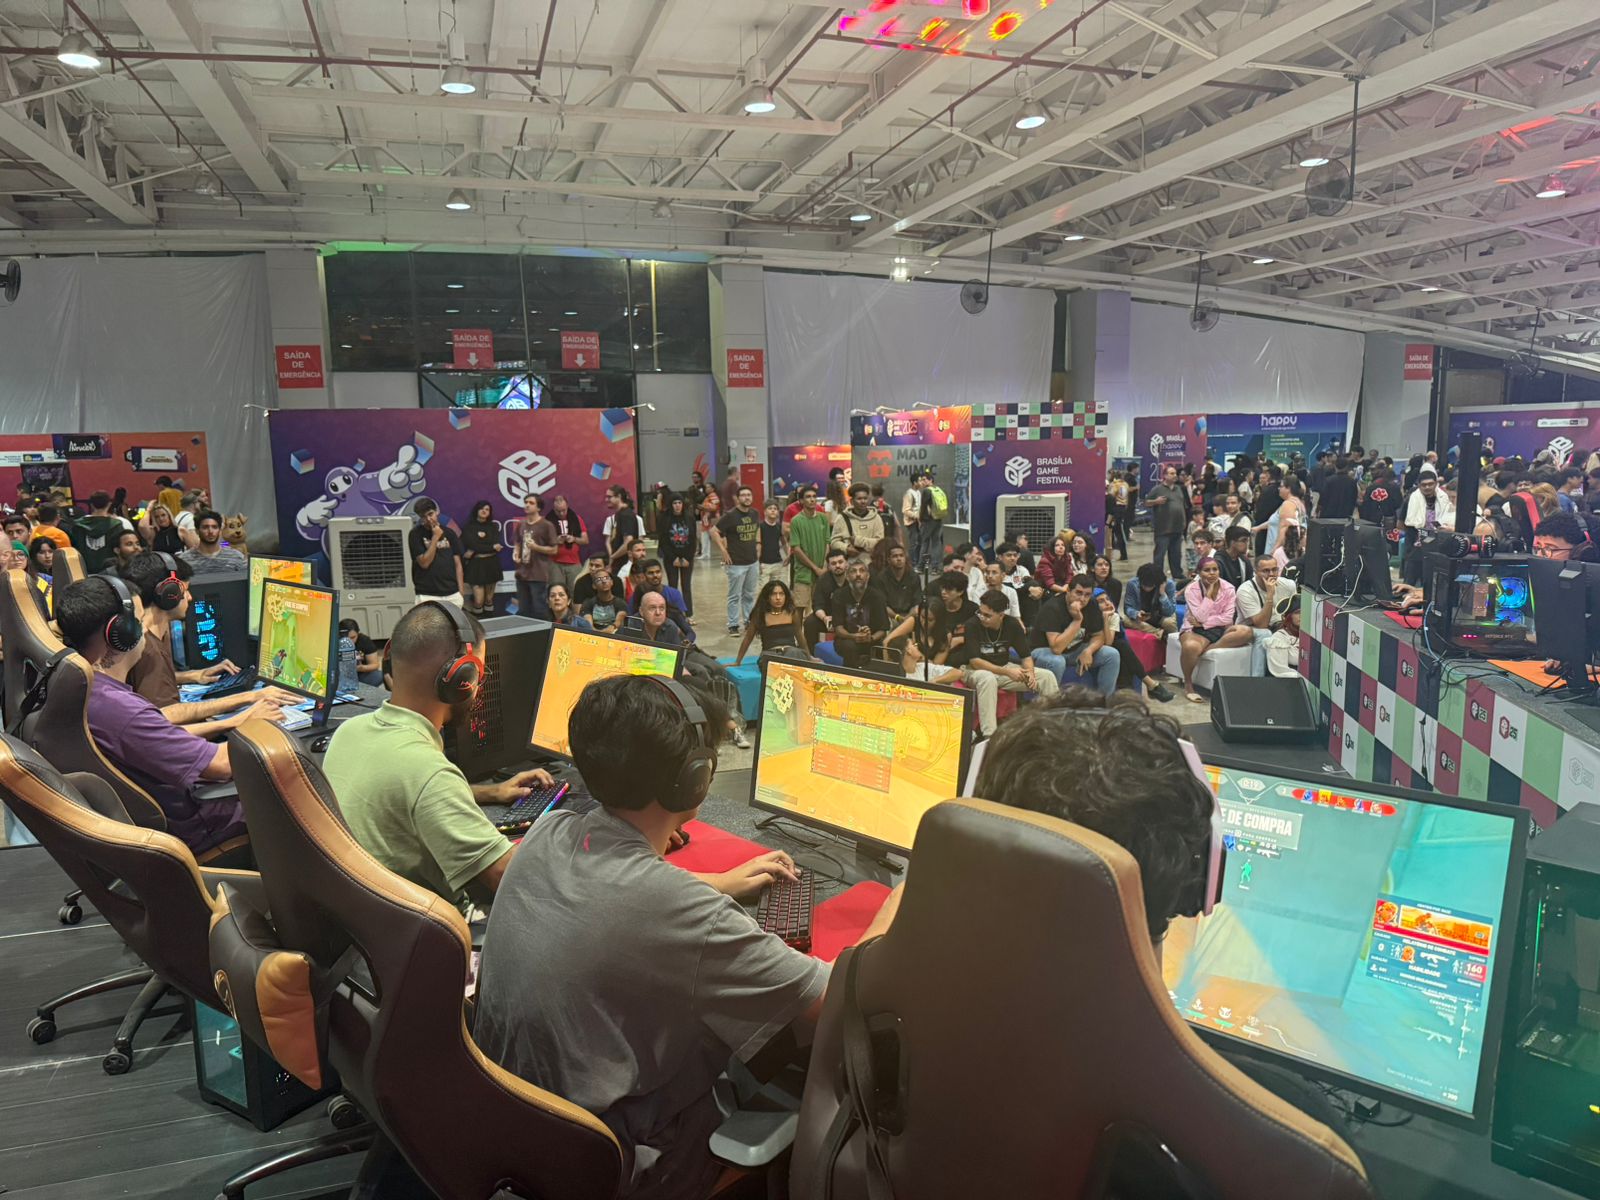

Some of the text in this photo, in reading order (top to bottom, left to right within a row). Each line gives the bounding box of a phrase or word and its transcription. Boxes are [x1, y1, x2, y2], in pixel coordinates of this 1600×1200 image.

[284, 350, 310, 359] SAÍDA
[280, 370, 321, 378] EMERGÊNCIA
[1260, 415, 1298, 426] happy
[896, 448, 928, 460] MAD
[1036, 456, 1073, 466] BRASÍLIA
[1036, 467, 1060, 475] GAME
[1036, 476, 1073, 484] FESTIVAL
[1509, 726, 1518, 740] 25
[1226, 808, 1242, 826] DE
[1243, 812, 1293, 836] COMPRA
[1466, 963, 1483, 974] 160
